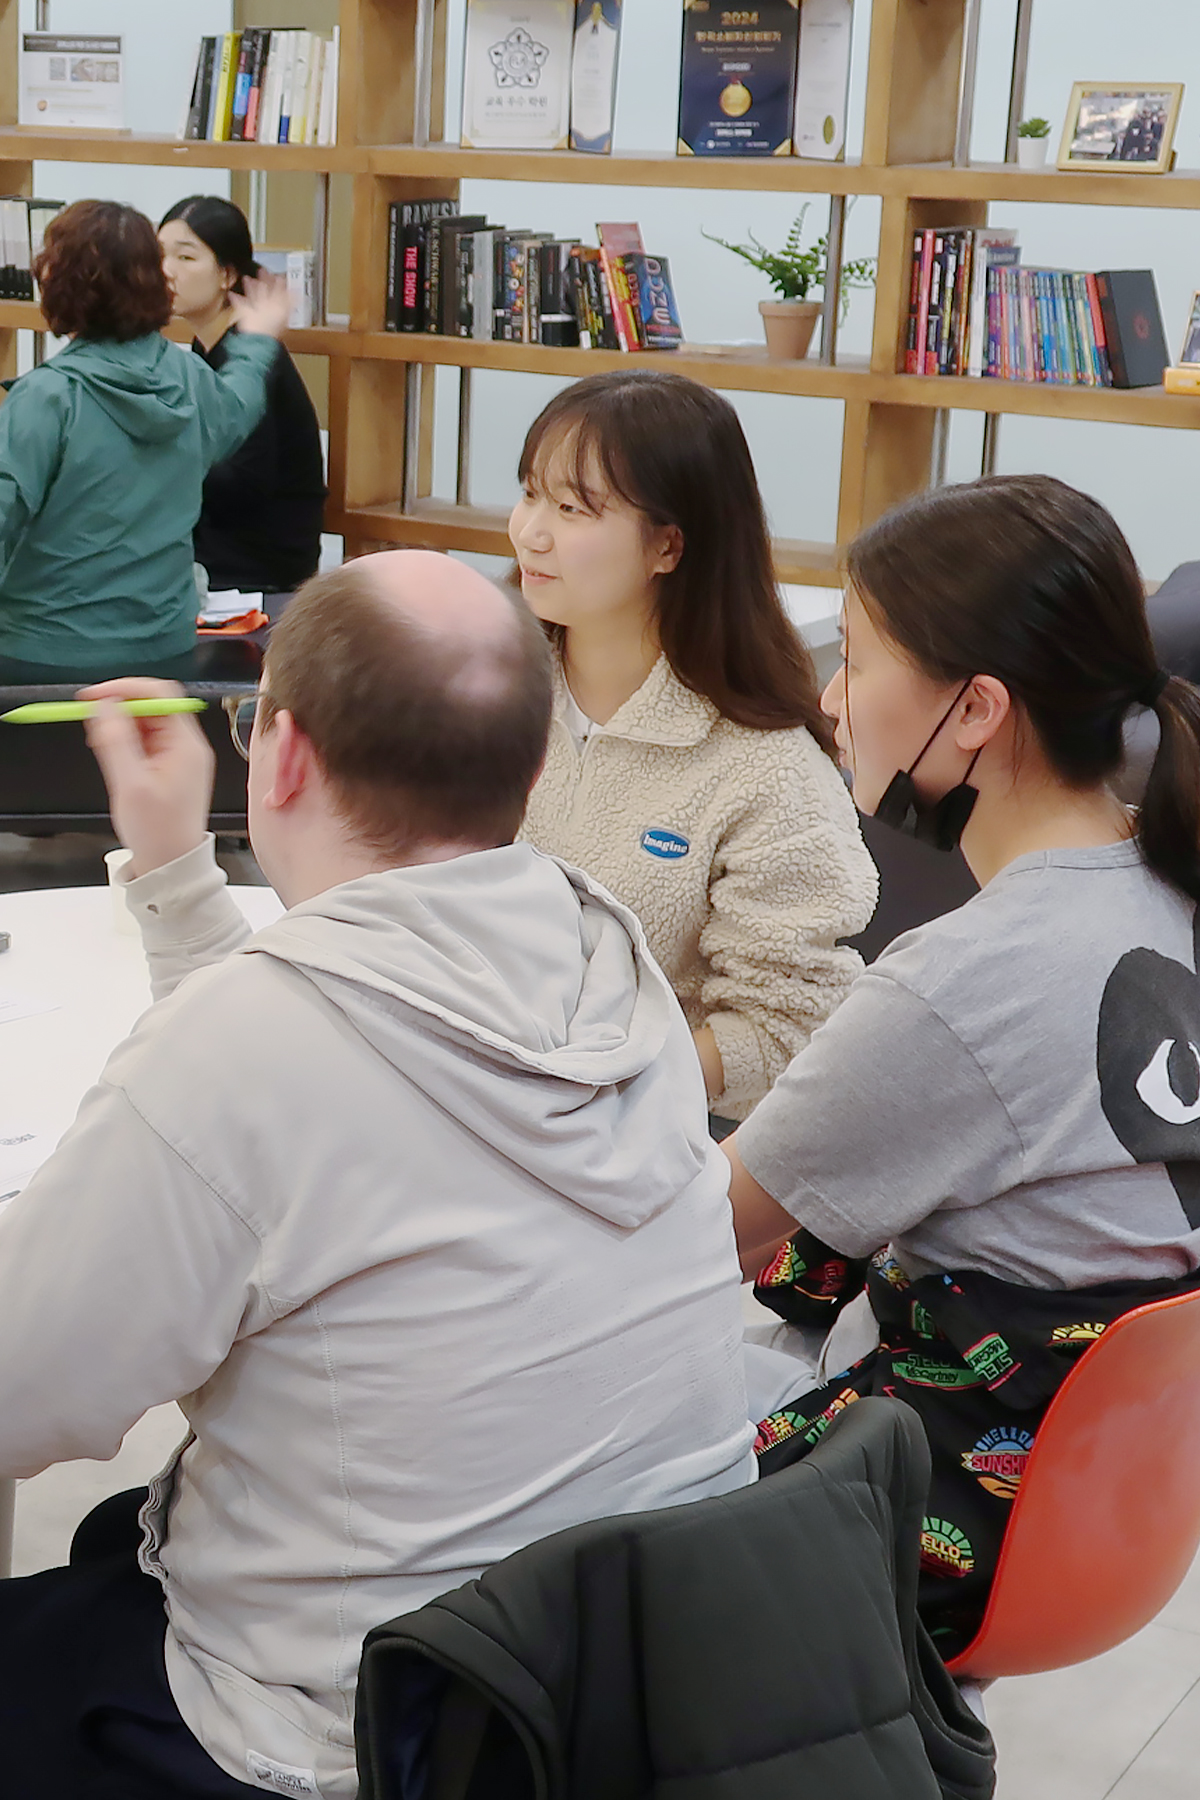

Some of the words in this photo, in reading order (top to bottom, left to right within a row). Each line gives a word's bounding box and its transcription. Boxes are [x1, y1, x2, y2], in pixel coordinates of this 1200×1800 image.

[721, 11, 759, 26] 2024
[404, 246, 418, 270] THE
[403, 271, 417, 308] SHOW
[645, 258, 671, 325] DUNE
[920, 1532, 961, 1560] ELLO
